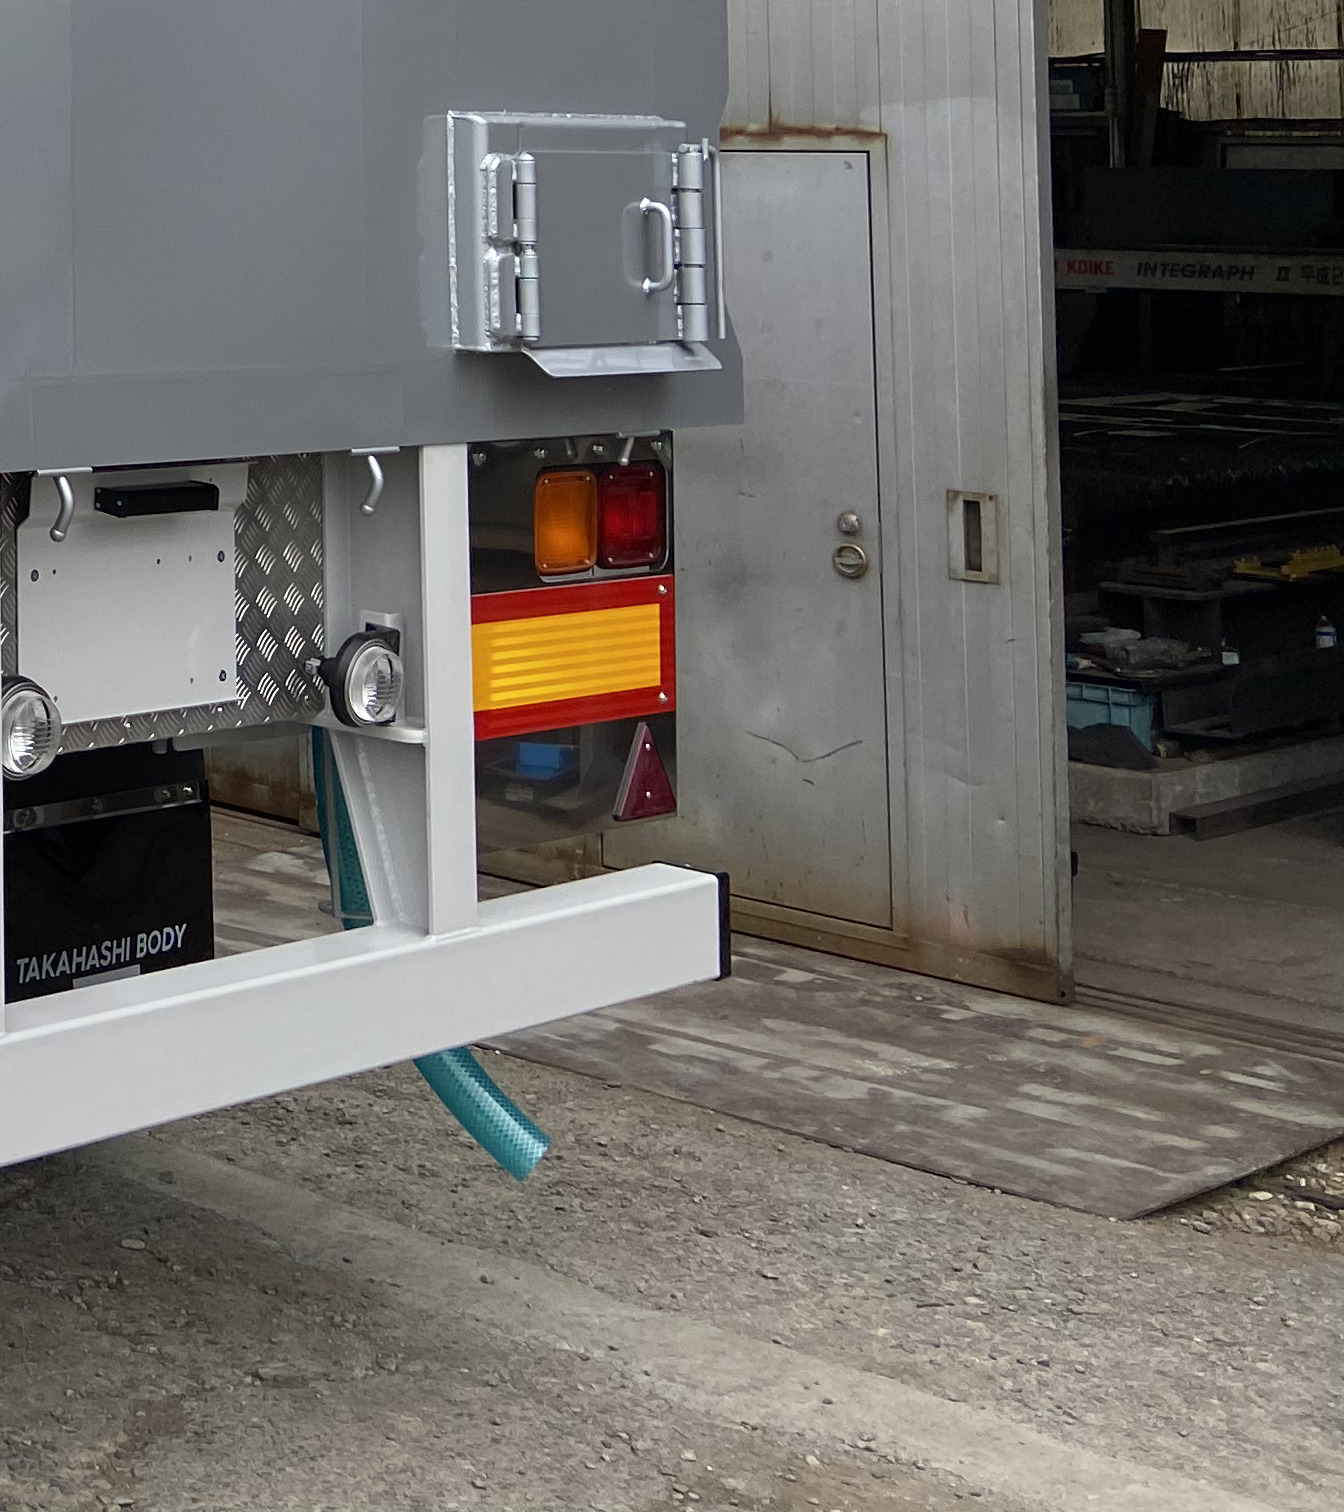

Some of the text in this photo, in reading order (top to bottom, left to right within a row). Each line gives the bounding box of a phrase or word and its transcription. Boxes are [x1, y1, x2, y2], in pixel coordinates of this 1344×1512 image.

[1067, 259, 1116, 276] KOIKE
[1136, 261, 1256, 281] INTEGRAPH
[16, 923, 187, 984] TAKAHASHI BODY
